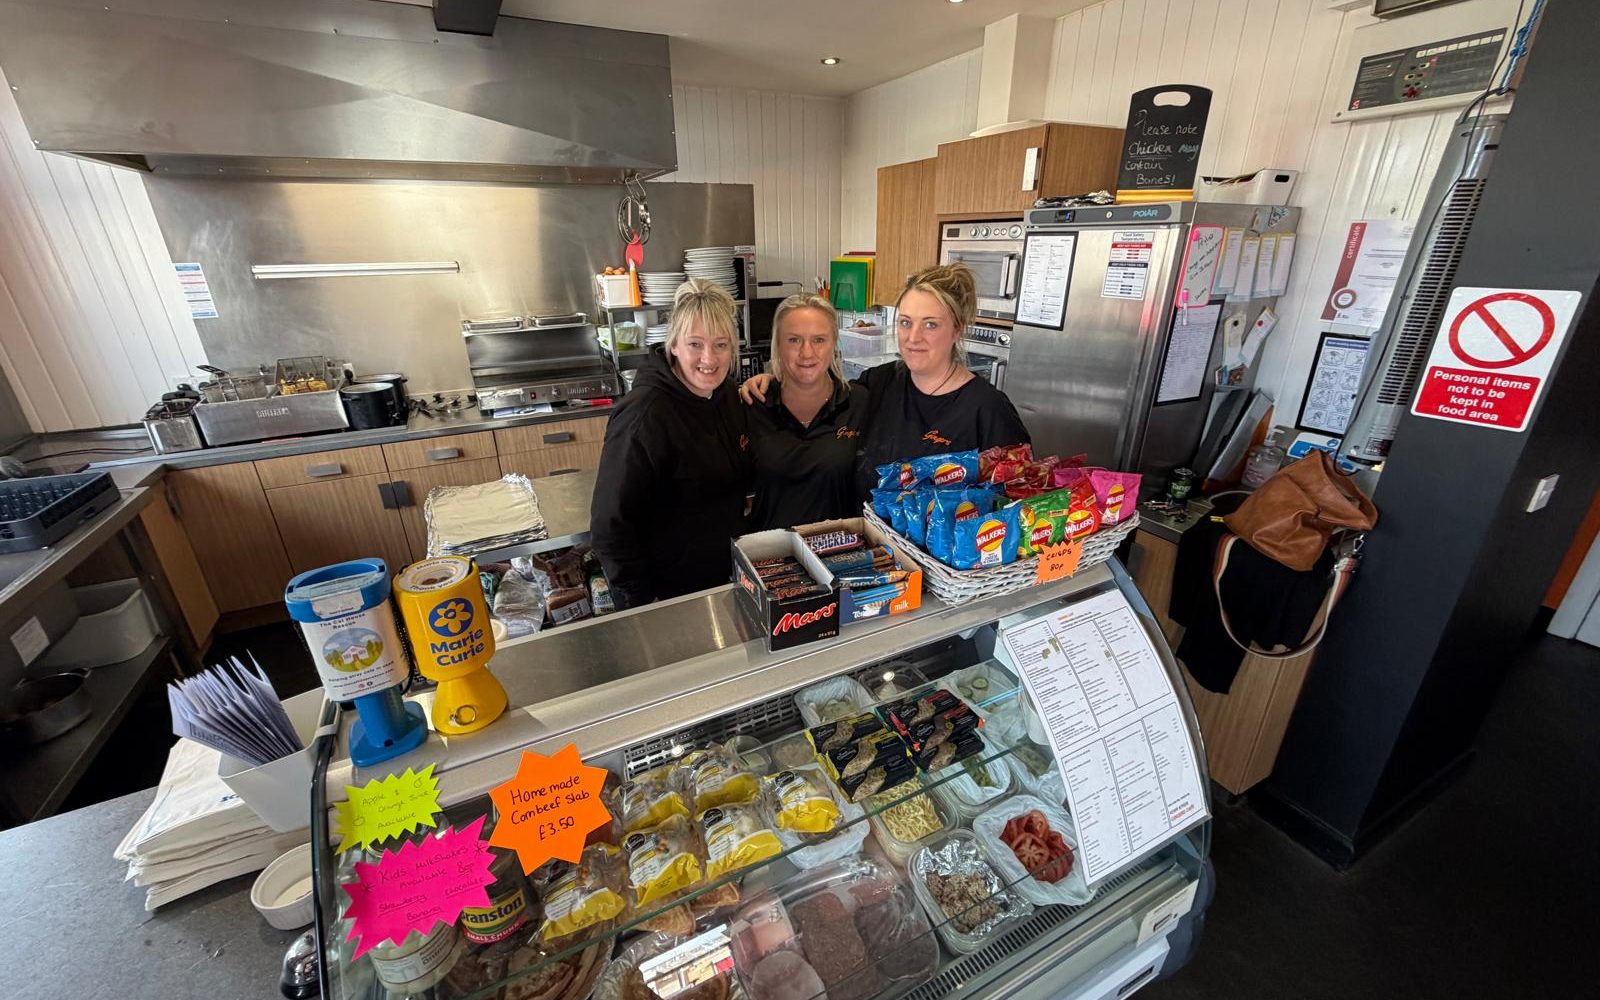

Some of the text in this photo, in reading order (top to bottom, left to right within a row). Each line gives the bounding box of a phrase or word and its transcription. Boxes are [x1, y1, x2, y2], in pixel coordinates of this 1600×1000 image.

[1134, 108, 1201, 136] Please note
[1128, 140, 1173, 156] Chicken
[1136, 173, 1176, 186] Bones!
[1346, 225, 1361, 259] certificate
[1434, 370, 1531, 391] Personal items
[1447, 384, 1506, 399] not to be
[1450, 395, 1494, 409] kept in
[1438, 404, 1499, 421] food area
[935, 469, 964, 484] WALKERS
[1065, 517, 1094, 534] WALKERS
[811, 534, 856, 551] SNICKERS
[976, 526, 1007, 547] WALKERS
[1031, 529, 1052, 542] WALKERS
[1046, 548, 1072, 560] CRISPS
[894, 601, 909, 611] milk
[345, 613, 366, 622] House
[773, 602, 837, 636] Mars
[333, 621, 356, 630] Rescue
[430, 628, 484, 655] Marie
[436, 642, 485, 667] Curie
[510, 775, 580, 805] Home made
[362, 793, 385, 808] Apple
[378, 799, 406, 813] Orange
[539, 816, 575, 841] £3.50
[379, 868, 407, 883] Kids
[466, 932, 489, 941] SMALL
